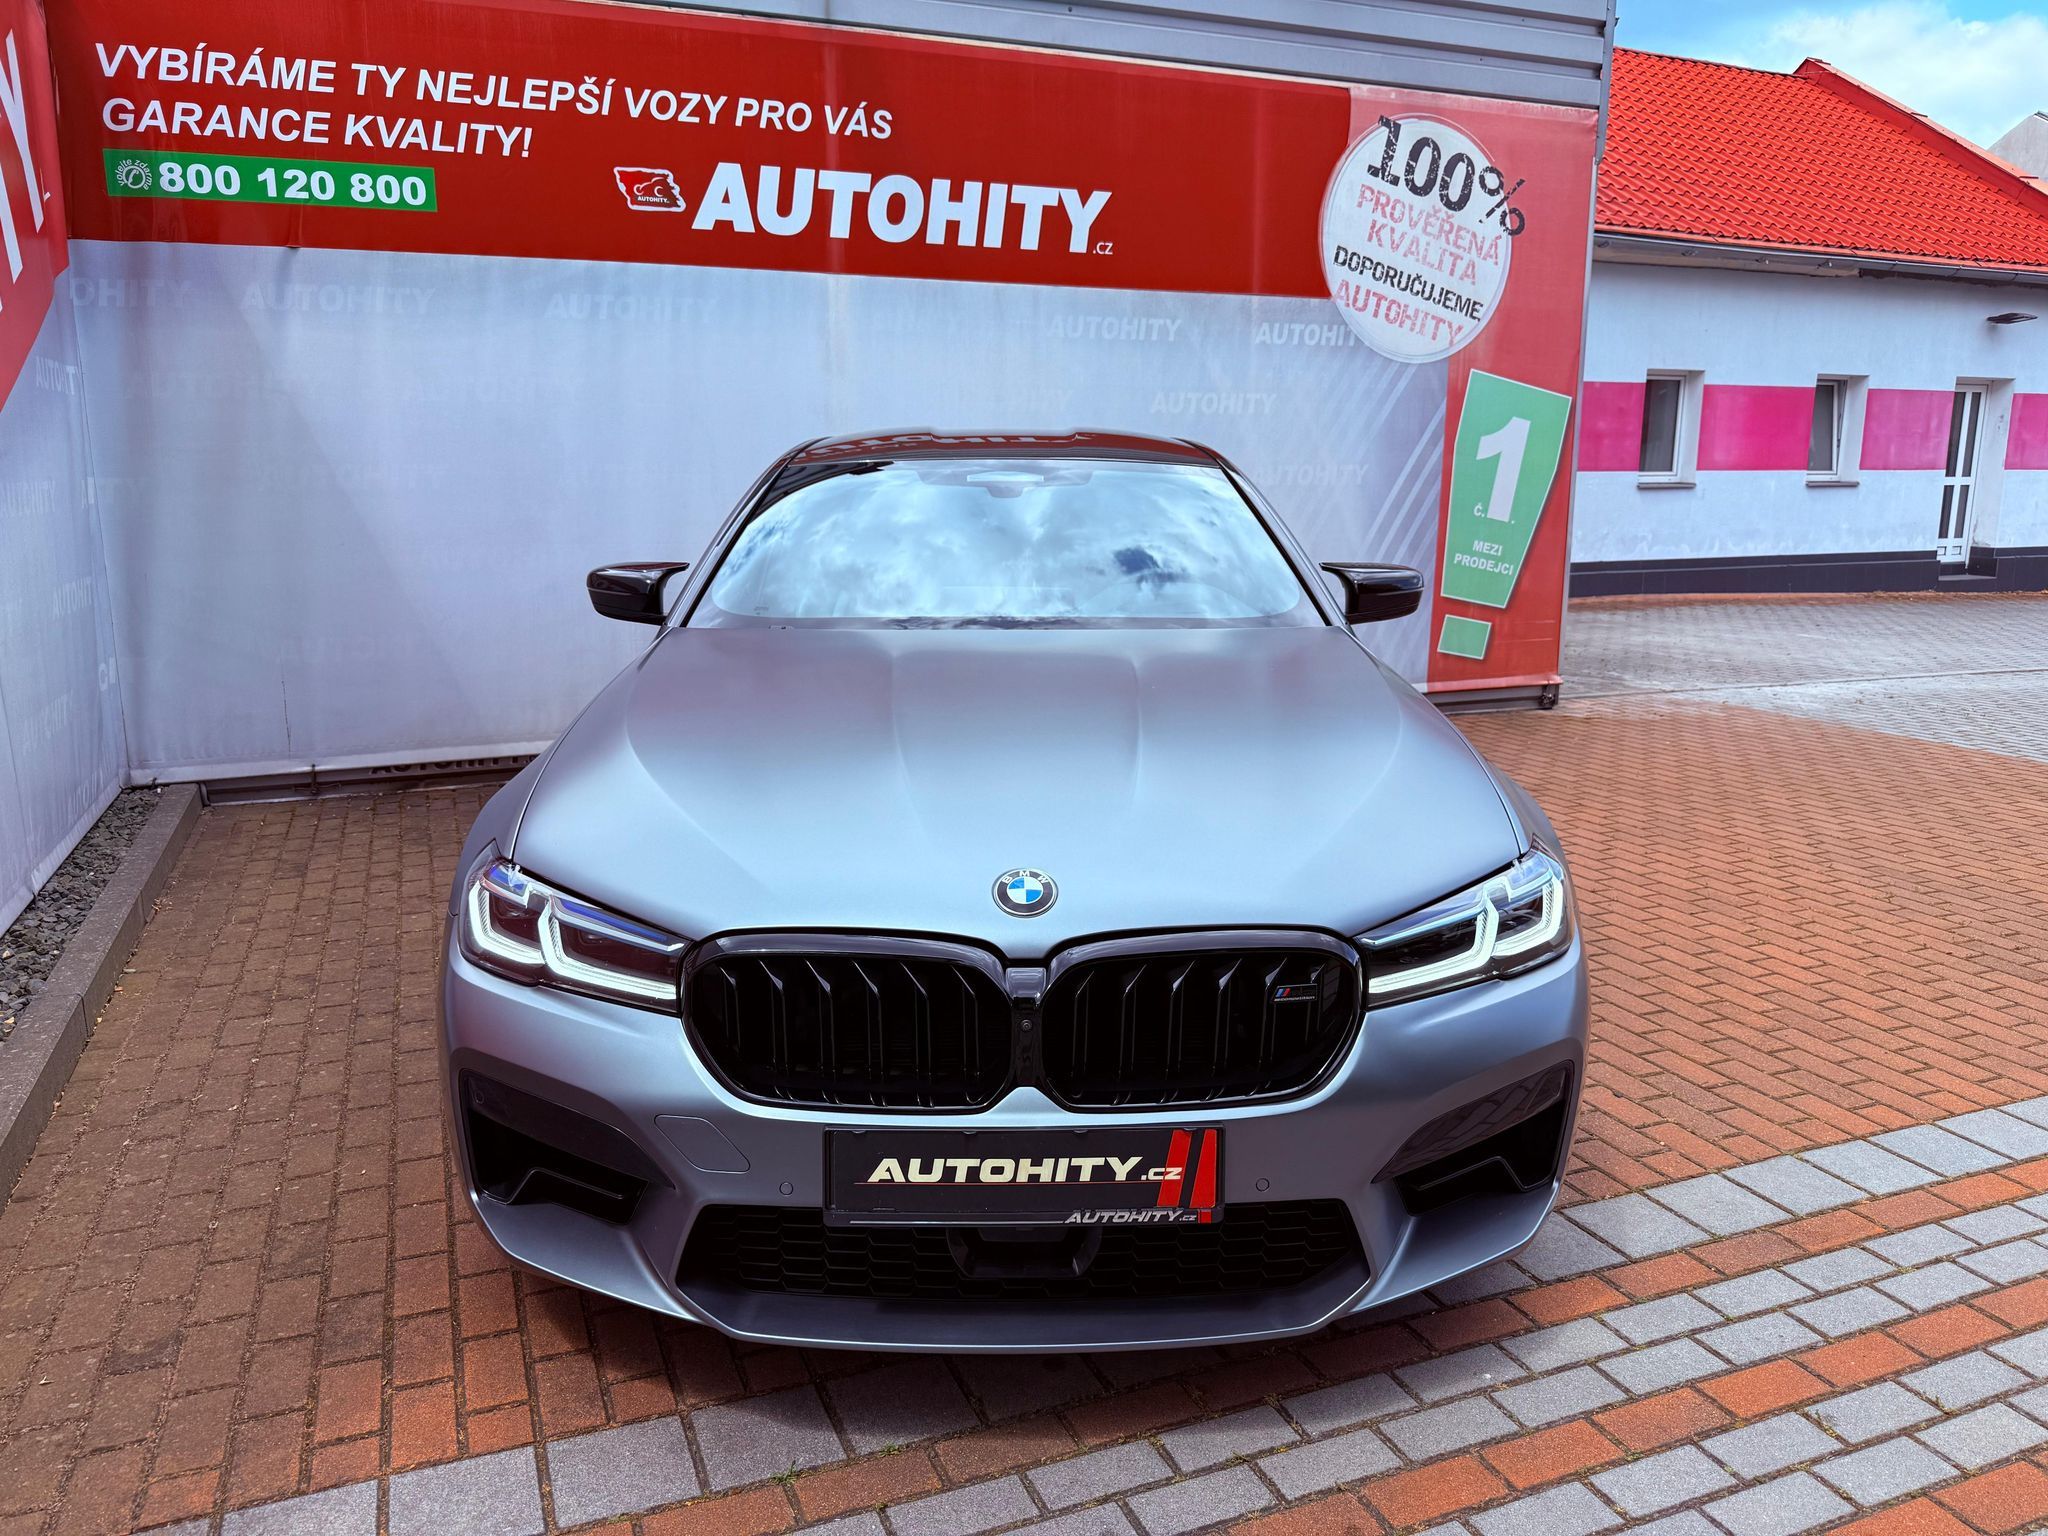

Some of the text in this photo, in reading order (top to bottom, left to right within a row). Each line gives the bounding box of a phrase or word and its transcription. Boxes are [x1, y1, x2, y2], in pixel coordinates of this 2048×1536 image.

[95, 42, 893, 140] VYBÍRÁME TY NEJLEPŠÍ VOZY PRO VÁS
[102, 97, 533, 158] GARANCE KVALITY!
[158, 161, 427, 206] 800 120 800
[1366, 115, 1526, 236] 100%
[1356, 183, 1503, 266] PROVĚŘENÁ
[1367, 219, 1477, 286] KVALITA
[1332, 244, 1485, 323] DOPORUČUJEME
[1335, 278, 1465, 347] AUTOHITY
[1048, 315, 1182, 342] AUTOHITY
[1150, 391, 1277, 416] AUTOHITY
[1453, 553, 1515, 576] PRODEJCI
[1472, 539, 1503, 557] MEZI
[1002, 869, 1049, 885] BMW
